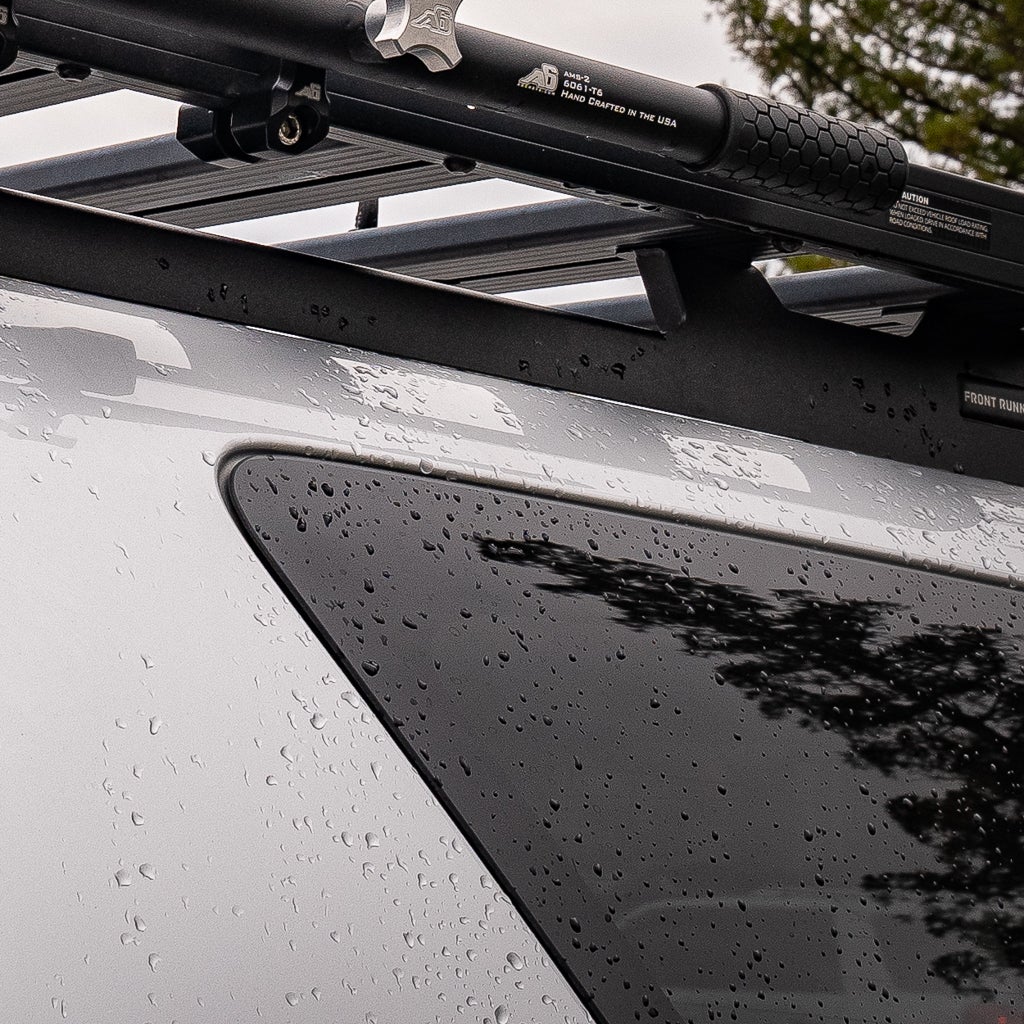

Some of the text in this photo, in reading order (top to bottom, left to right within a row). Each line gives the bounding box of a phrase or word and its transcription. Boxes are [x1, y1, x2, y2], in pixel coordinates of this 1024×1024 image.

[563, 79, 604, 97] 6061-T6
[657, 115, 677, 128] USA
[901, 190, 928, 205] AUTION
[964, 391, 996, 408] FRONT
